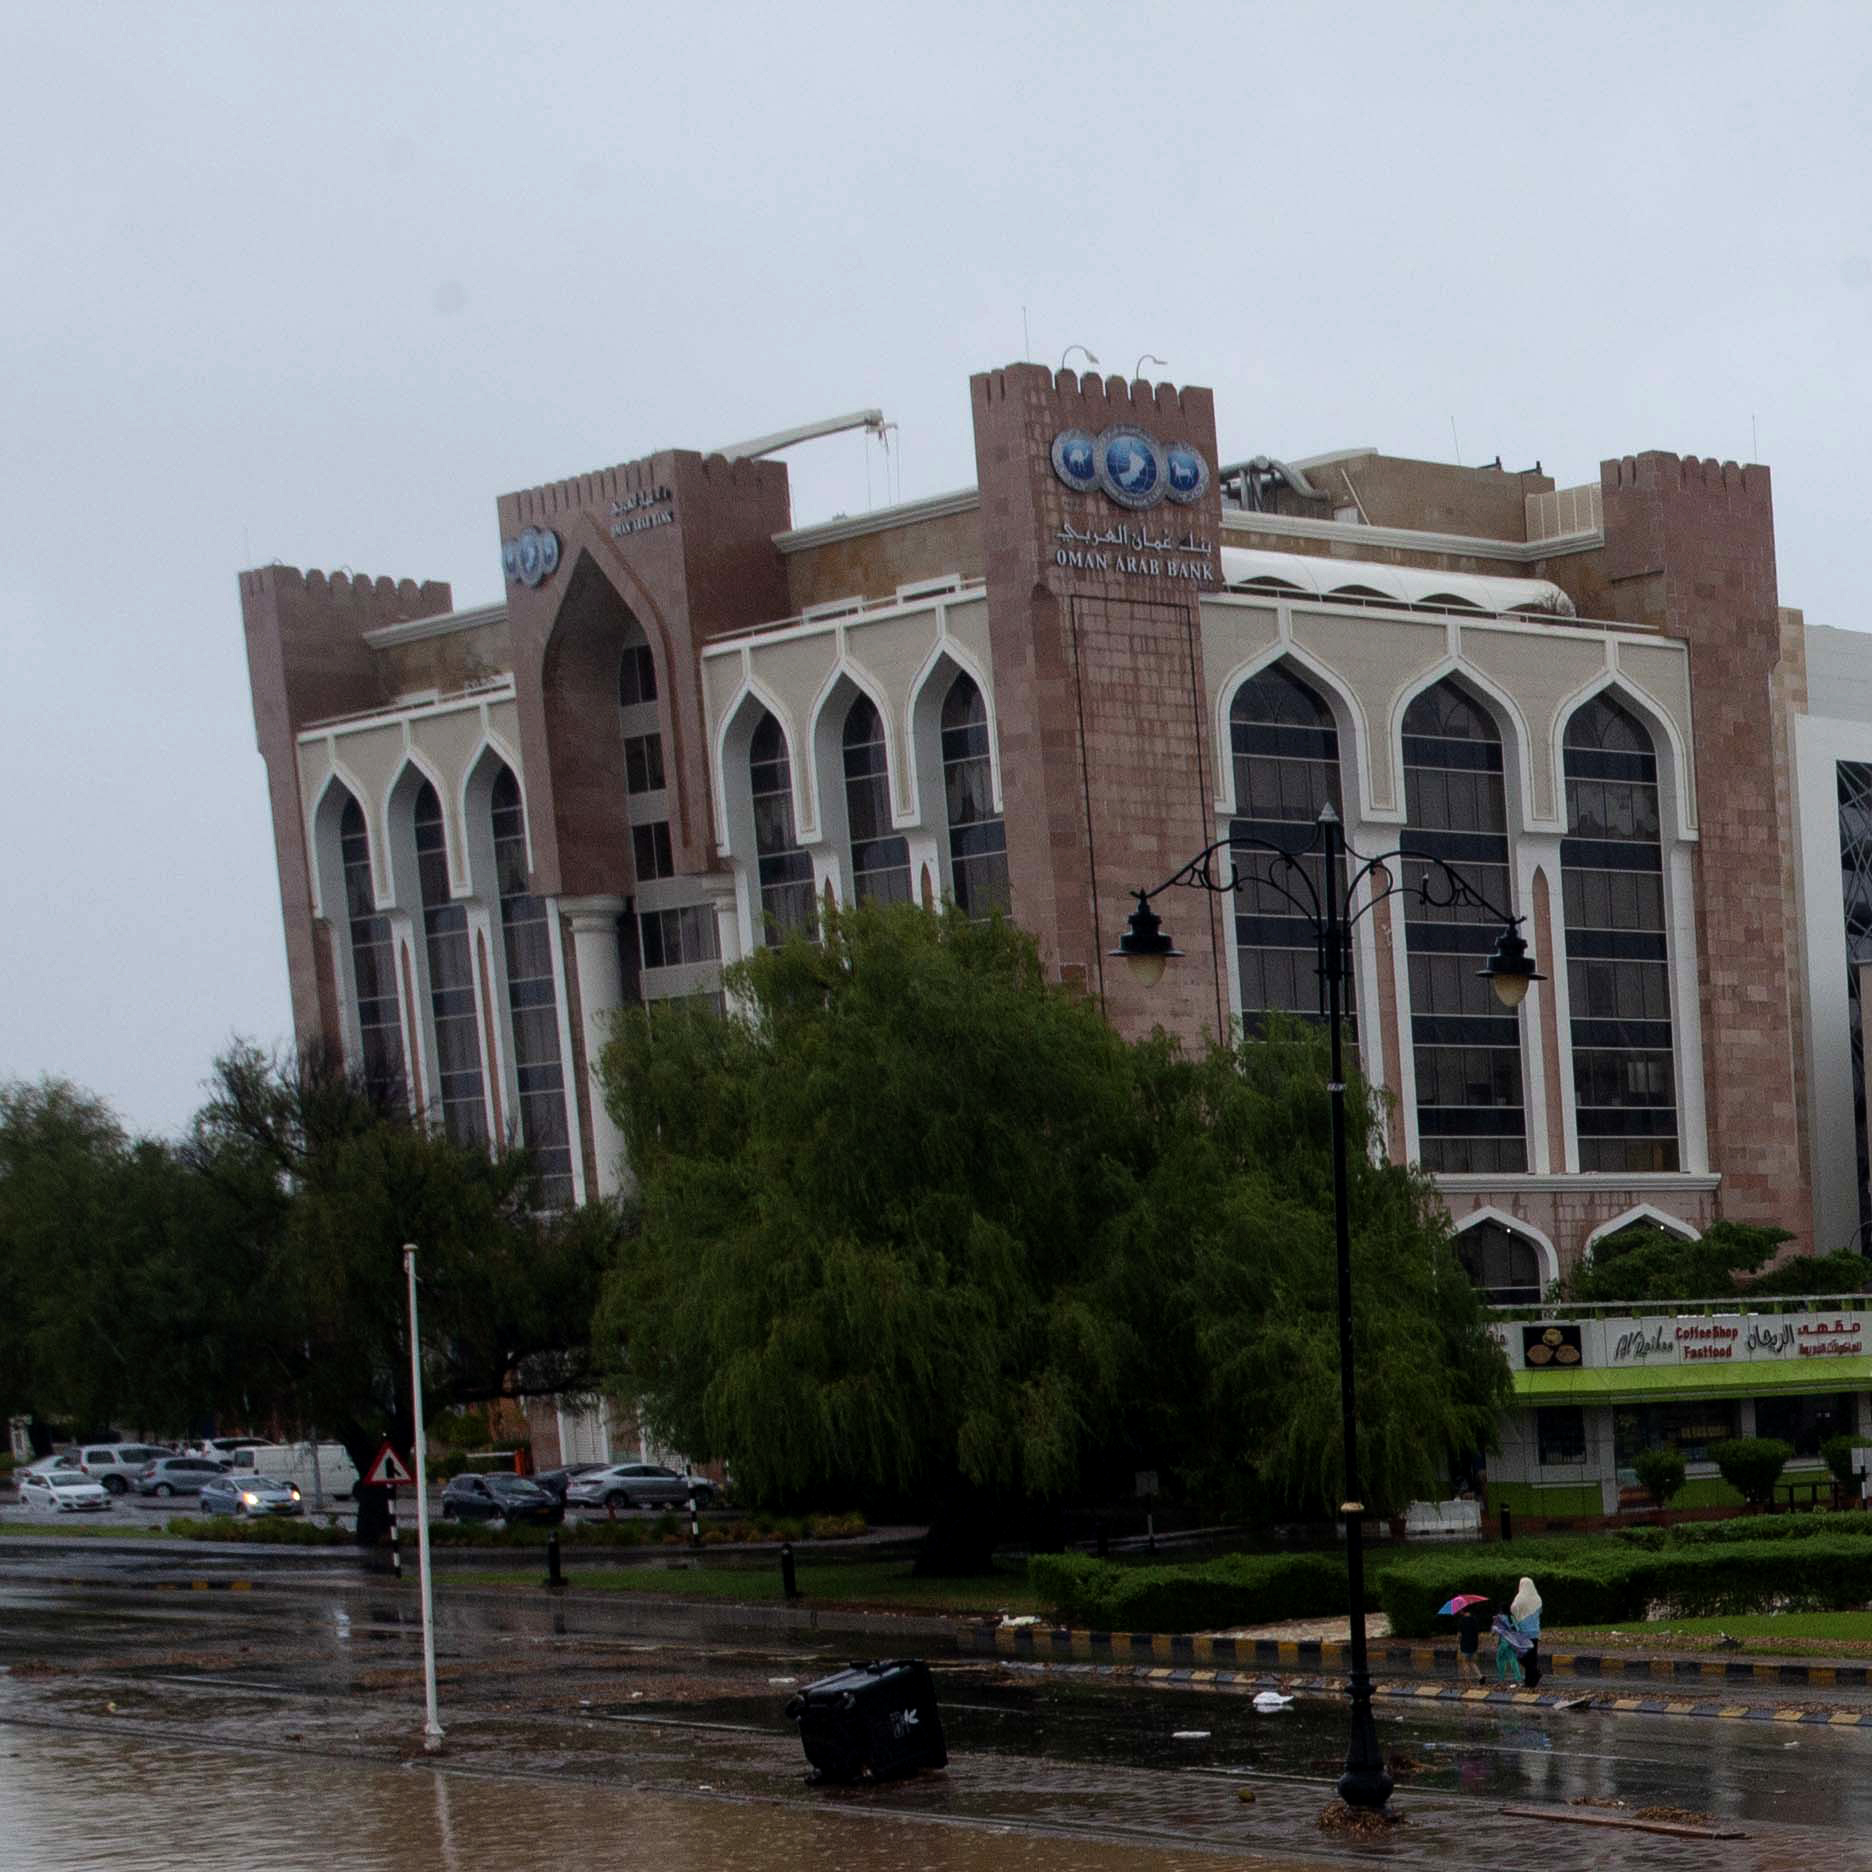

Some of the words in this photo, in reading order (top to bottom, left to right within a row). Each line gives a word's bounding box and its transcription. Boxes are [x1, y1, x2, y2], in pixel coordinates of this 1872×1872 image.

[1056, 520, 1128, 545] العربي
[1180, 530, 1212, 556] بنك
[1056, 550, 1107, 569] OMAN
[1115, 556, 1159, 576] ARAB
[1167, 561, 1214, 580] BANK
